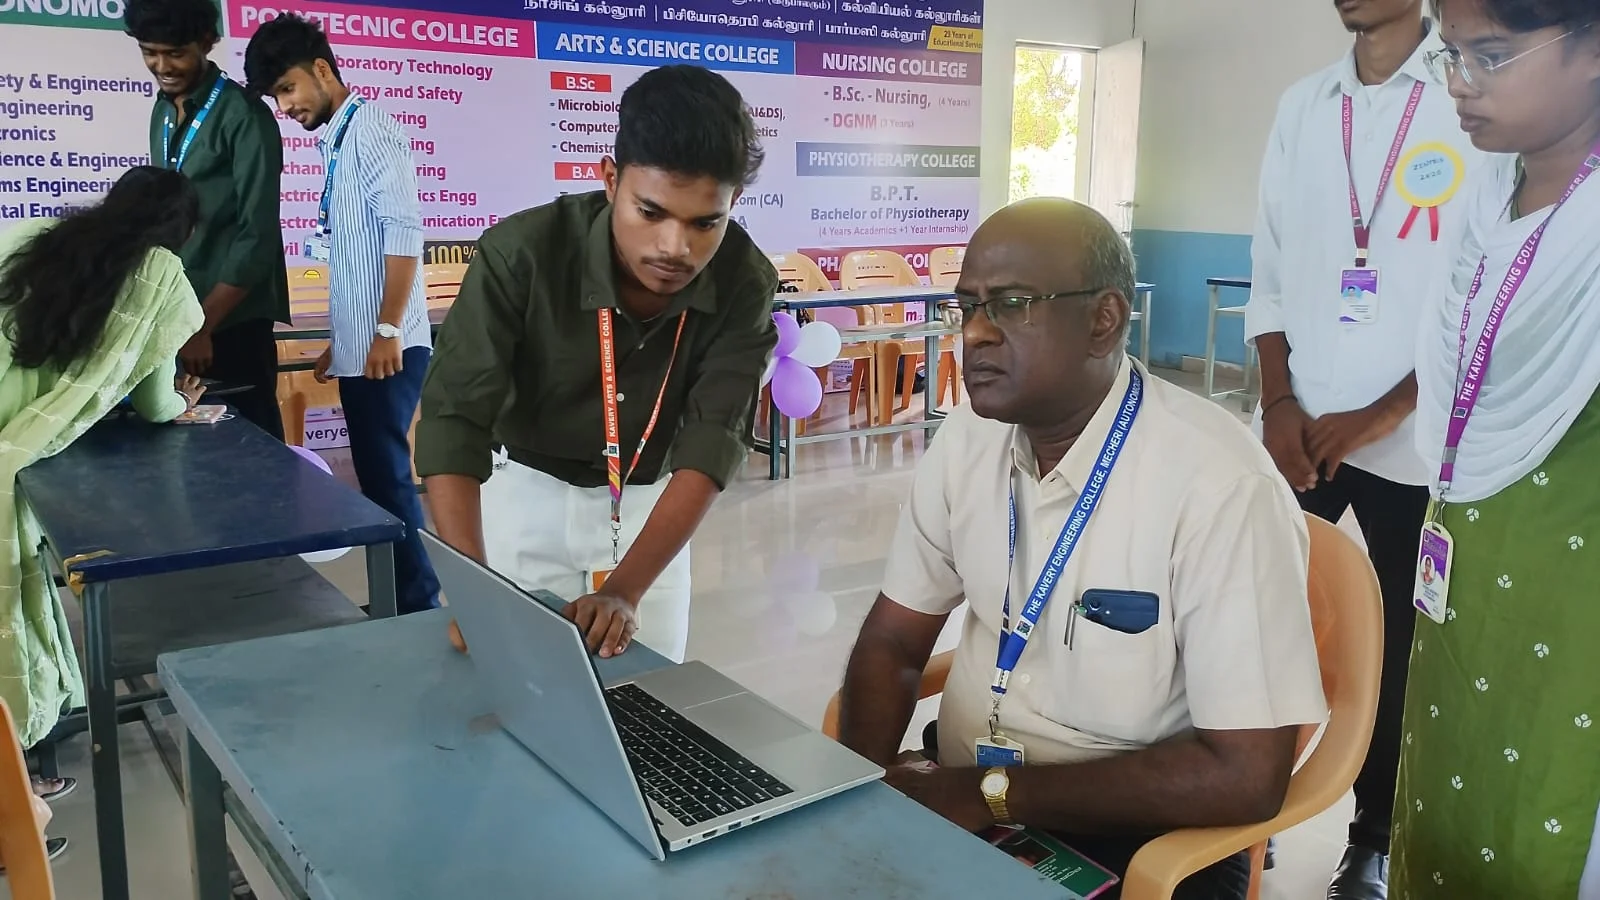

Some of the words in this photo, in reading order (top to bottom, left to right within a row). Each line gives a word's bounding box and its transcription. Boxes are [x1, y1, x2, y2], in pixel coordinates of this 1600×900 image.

[411, 19, 519, 48] COLLEGE
[555, 32, 605, 54] ARTS
[609, 37, 624, 55] &
[627, 39, 701, 60] SCIENCE
[704, 44, 779, 65] COLLEGE
[407, 59, 493, 81] Technology
[822, 53, 896, 74] NURSING
[899, 58, 968, 79] COLLEGE
[29, 73, 42, 89] &
[47, 74, 154, 97] Engineering
[565, 76, 596, 90] B.Sc
[385, 86, 413, 98] and
[418, 86, 463, 104] Safety
[833, 86, 865, 102] B.Sc.
[875, 88, 931, 109] Nursing,
[559, 120, 619, 135] Computer
[833, 113, 877, 130] DGNM
[0, 125, 56, 141] ronics
[50, 152, 62, 167] &
[809, 151, 919, 168] PHYSIOTHERAPY
[921, 154, 976, 168] COLLEGE
[572, 166, 596, 179] B.A
[440, 190, 477, 206] Engg
[760, 194, 783, 208] (CA)
[870, 186, 918, 201] B.P.T.
[811, 208, 867, 220] Bachelor
[870, 207, 884, 220] of
[886, 207, 970, 223] Physiotherapy
[829, 227, 851, 236] Years
[854, 226, 897, 236] Academics
[911, 225, 927, 234] Year
[929, 224, 968, 235] Internship)
[1460, 380, 1475, 402] THE
[1468, 338, 1488, 380] KAVERY
[1483, 266, 1521, 339] ENGINEERING
[603, 339, 612, 373] SCIENCE
[606, 384, 614, 404] ARTS
[607, 406, 616, 437] KAVERY
[1026, 598, 1041, 616] THE
[1036, 565, 1058, 600] KAVERY
[1052, 510, 1086, 566] ENGINEERING
[1081, 469, 1108, 510] COLLEGE,
[1100, 429, 1123, 468] MECHERI
